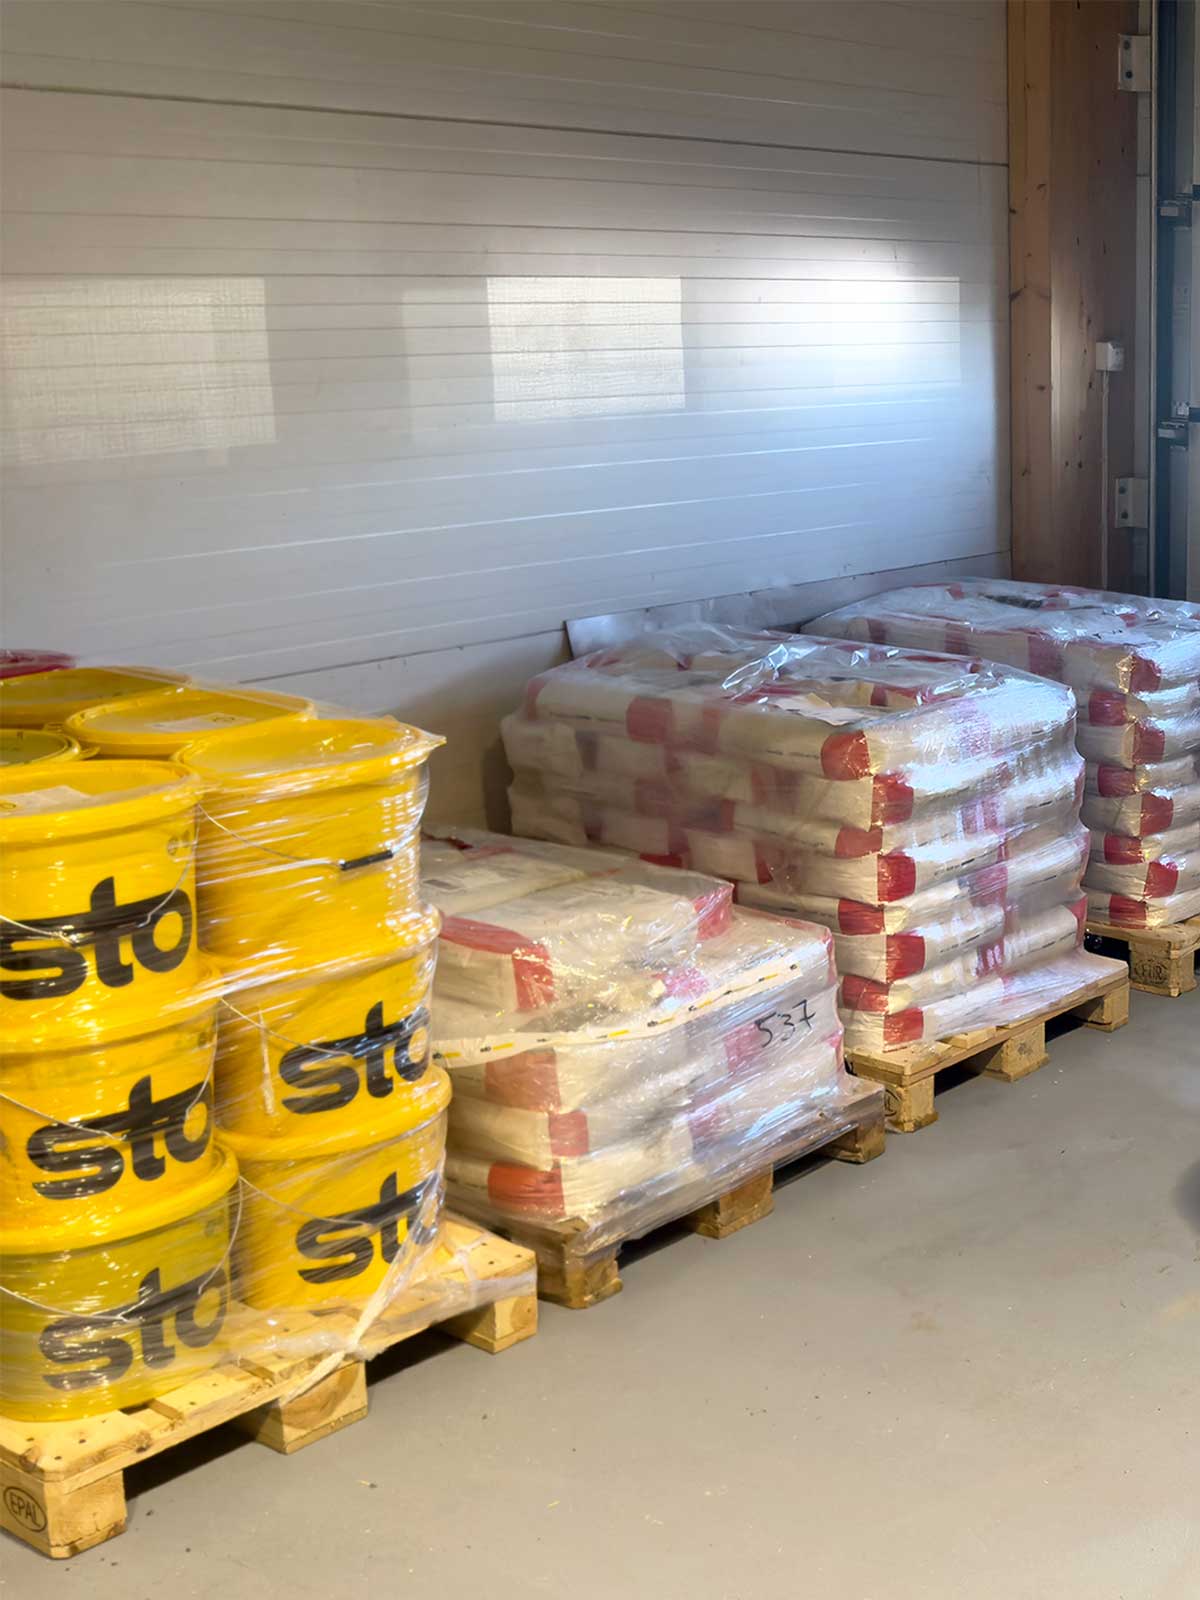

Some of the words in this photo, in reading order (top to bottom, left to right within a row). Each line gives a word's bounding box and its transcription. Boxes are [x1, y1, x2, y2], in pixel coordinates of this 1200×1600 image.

[0, 876, 192, 1001] sto
[279, 1001, 430, 1114] sto
[754, 999, 817, 1048] 537
[27, 1074, 212, 1199] sto
[296, 1171, 442, 1284] sto
[39, 1267, 228, 1391] sto
[9, 1491, 42, 1528] EPAL
